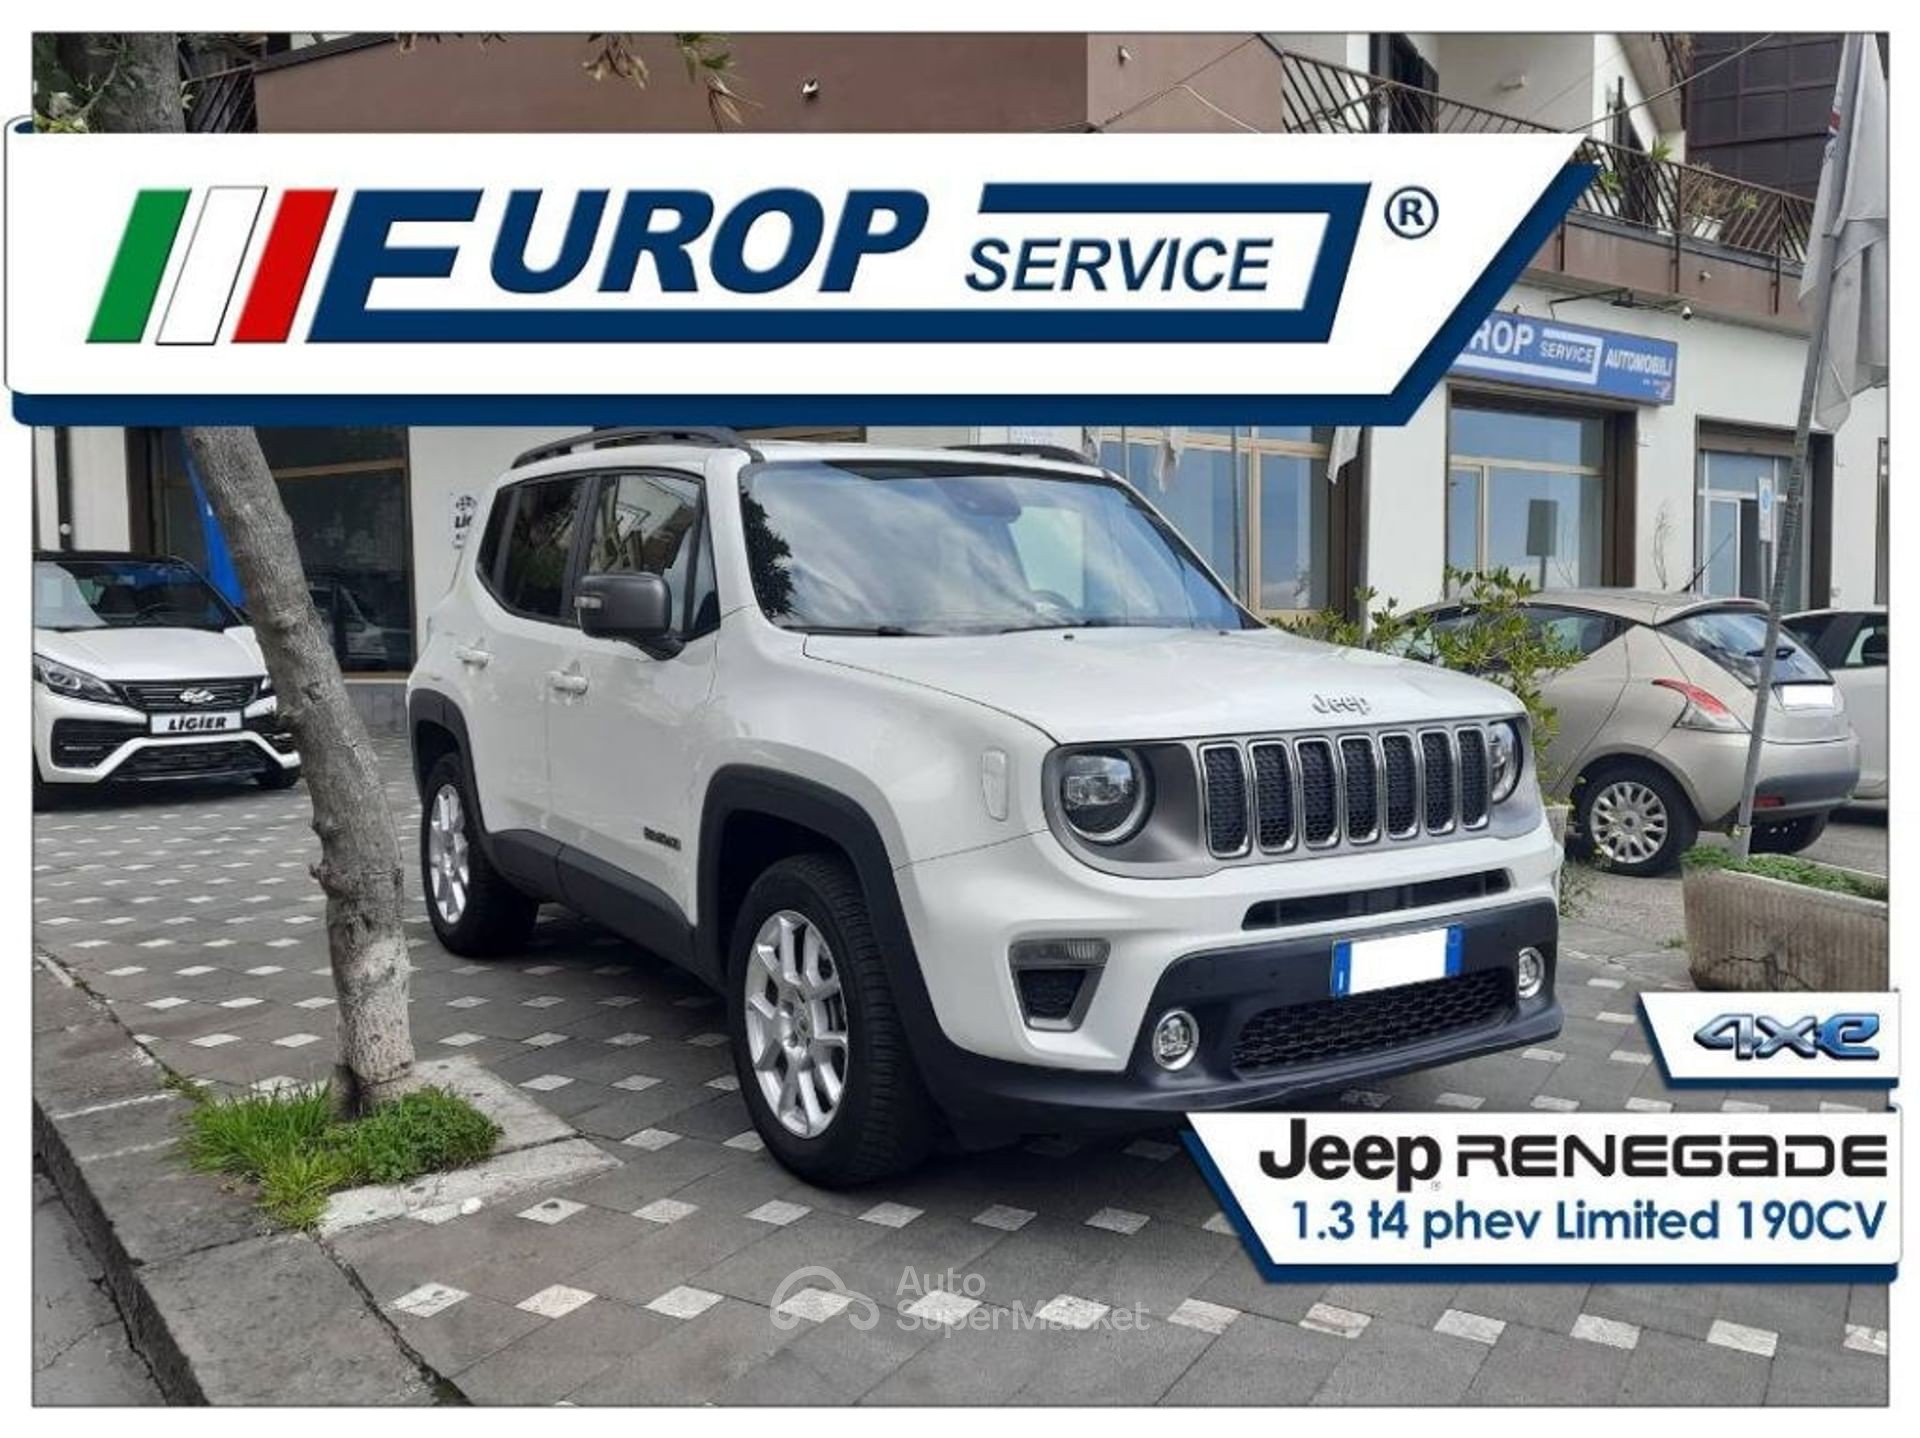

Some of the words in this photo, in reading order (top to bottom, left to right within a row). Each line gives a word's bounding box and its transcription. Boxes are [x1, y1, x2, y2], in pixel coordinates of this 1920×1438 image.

[1469, 319, 1535, 355] ROP
[1539, 340, 1594, 365] SERVICE
[1604, 347, 1673, 378] AUTOMOBILI
[1311, 692, 1372, 716] Jeep
